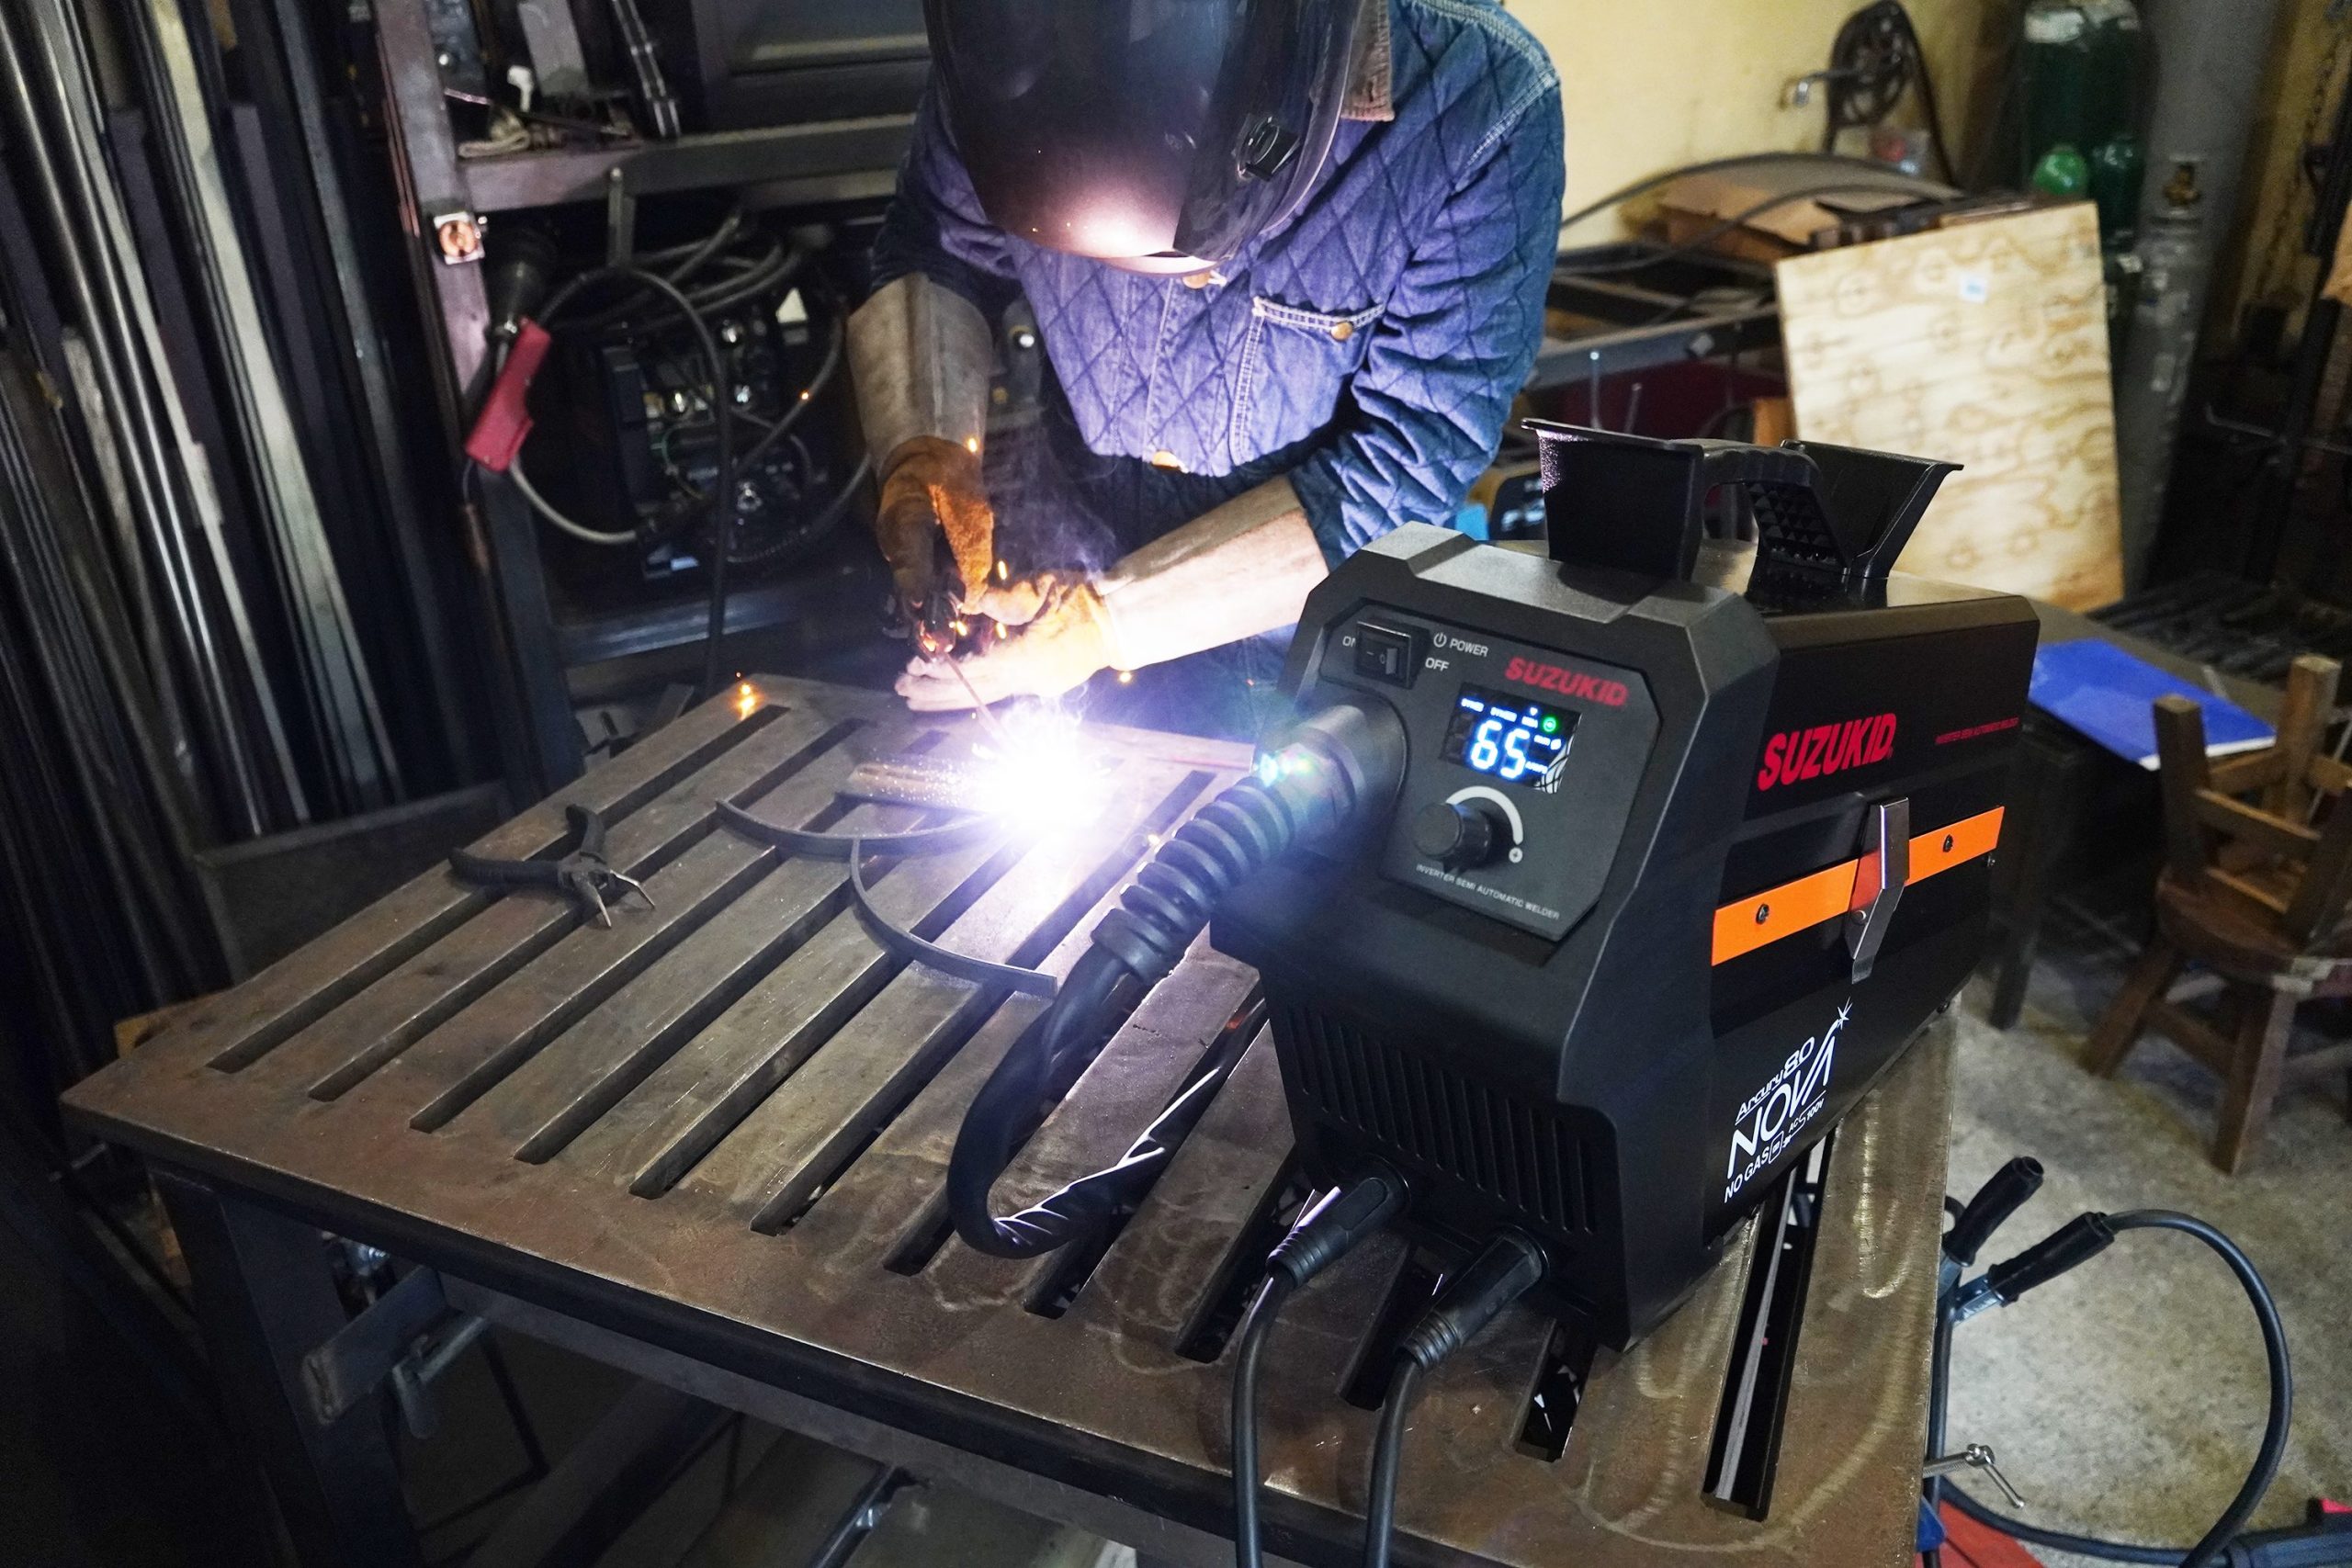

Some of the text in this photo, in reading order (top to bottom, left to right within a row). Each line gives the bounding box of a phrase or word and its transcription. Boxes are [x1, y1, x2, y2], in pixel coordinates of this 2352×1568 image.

[1425, 657, 1449, 672] OFF
[1450, 637, 1488, 658] POWER
[1505, 656, 1629, 708] SUZUKID
[1471, 720, 1531, 778] 65
[1758, 713, 1896, 791] SUZUKID
[1416, 863, 1560, 919] INVERTER SEMI AUTOMATIC WELDER
[1727, 1017, 1841, 1179] NOVA
[1724, 1145, 1770, 1203] NO GAS
